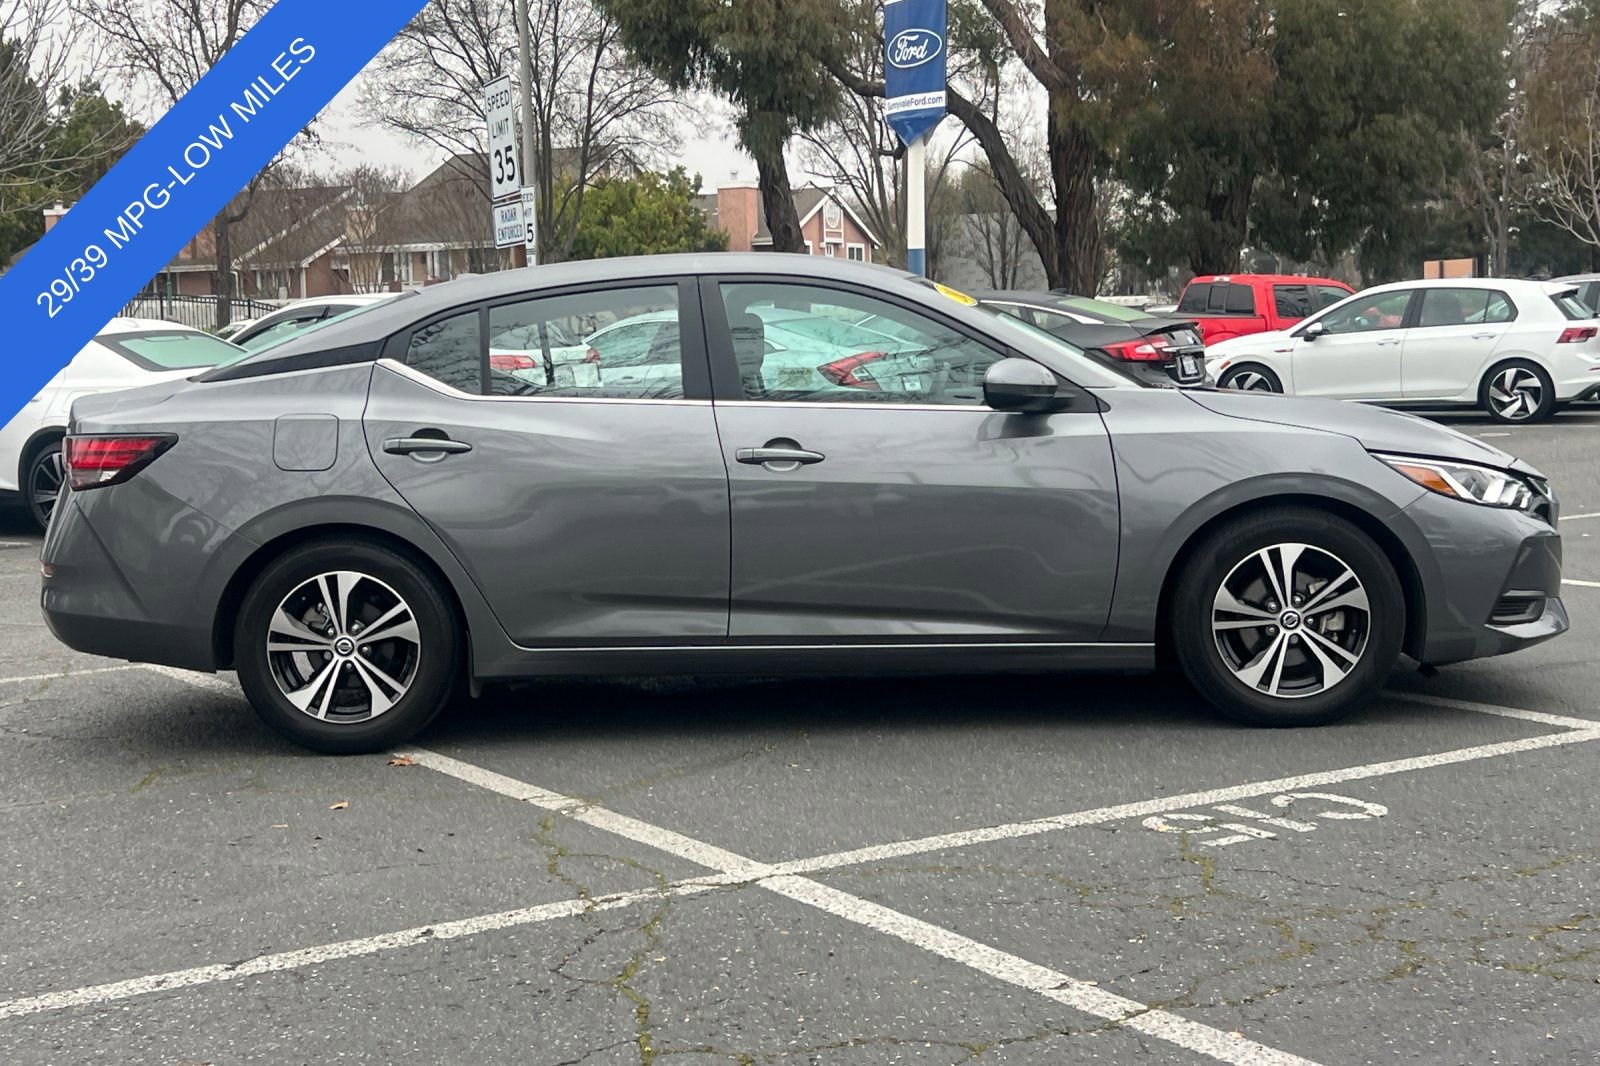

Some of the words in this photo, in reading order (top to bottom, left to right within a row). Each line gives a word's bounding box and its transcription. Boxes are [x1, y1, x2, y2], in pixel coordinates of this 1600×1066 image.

[895, 35, 928, 62] Ford
[488, 89, 510, 112] SPEED
[492, 118, 509, 139] LIMIT
[494, 145, 516, 185] 35
[500, 207, 517, 223] RADAR
[498, 224, 523, 242] ENFORCED
[527, 223, 534, 243] 5
